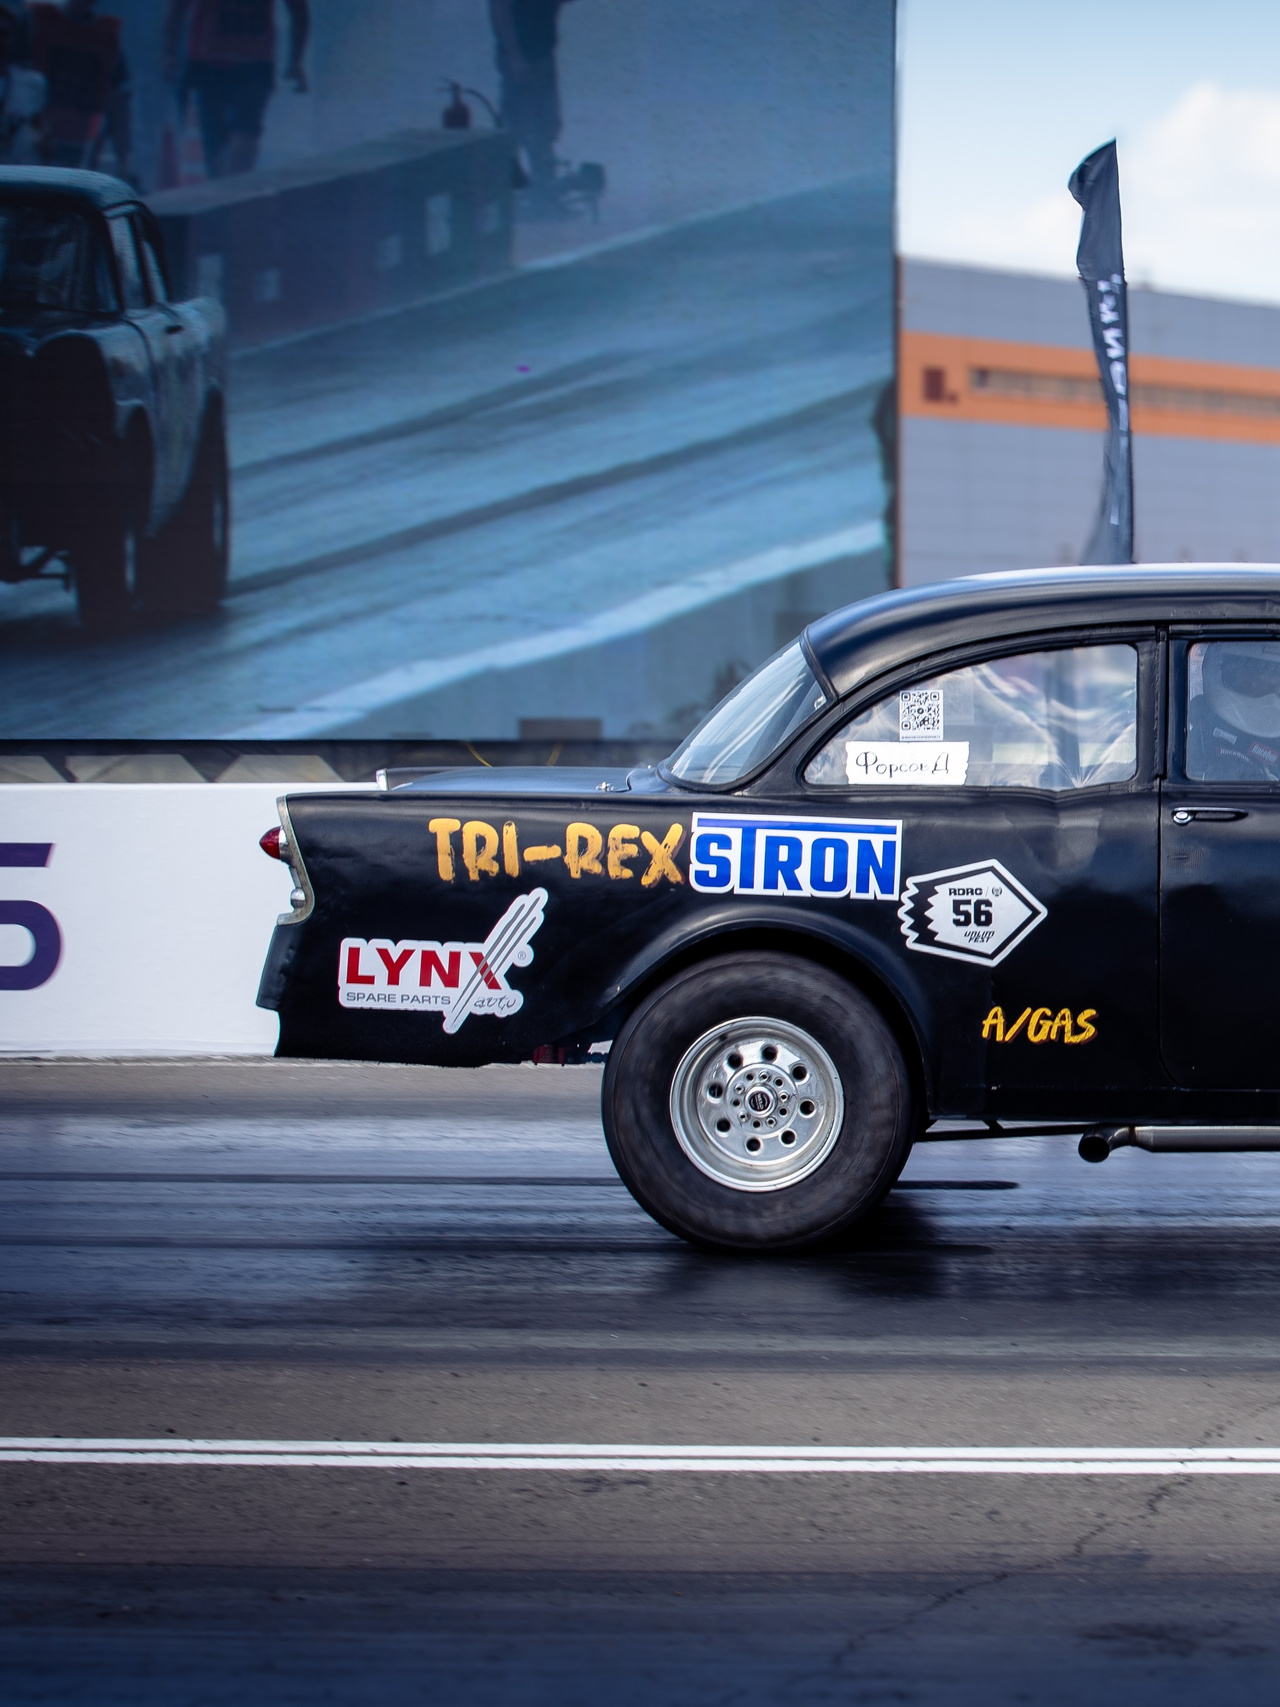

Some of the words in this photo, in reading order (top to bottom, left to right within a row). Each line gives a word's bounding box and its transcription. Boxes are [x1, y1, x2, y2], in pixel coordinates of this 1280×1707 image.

[428, 817, 687, 888] TRI-REX
[694, 817, 898, 896] STRON
[948, 888, 983, 896] RDRC
[953, 899, 993, 927] 56
[346, 946, 502, 991] LYNX
[346, 991, 397, 1004] SPARE
[400, 993, 451, 1005] PARTS
[982, 1006, 1098, 1045] A/GAS
